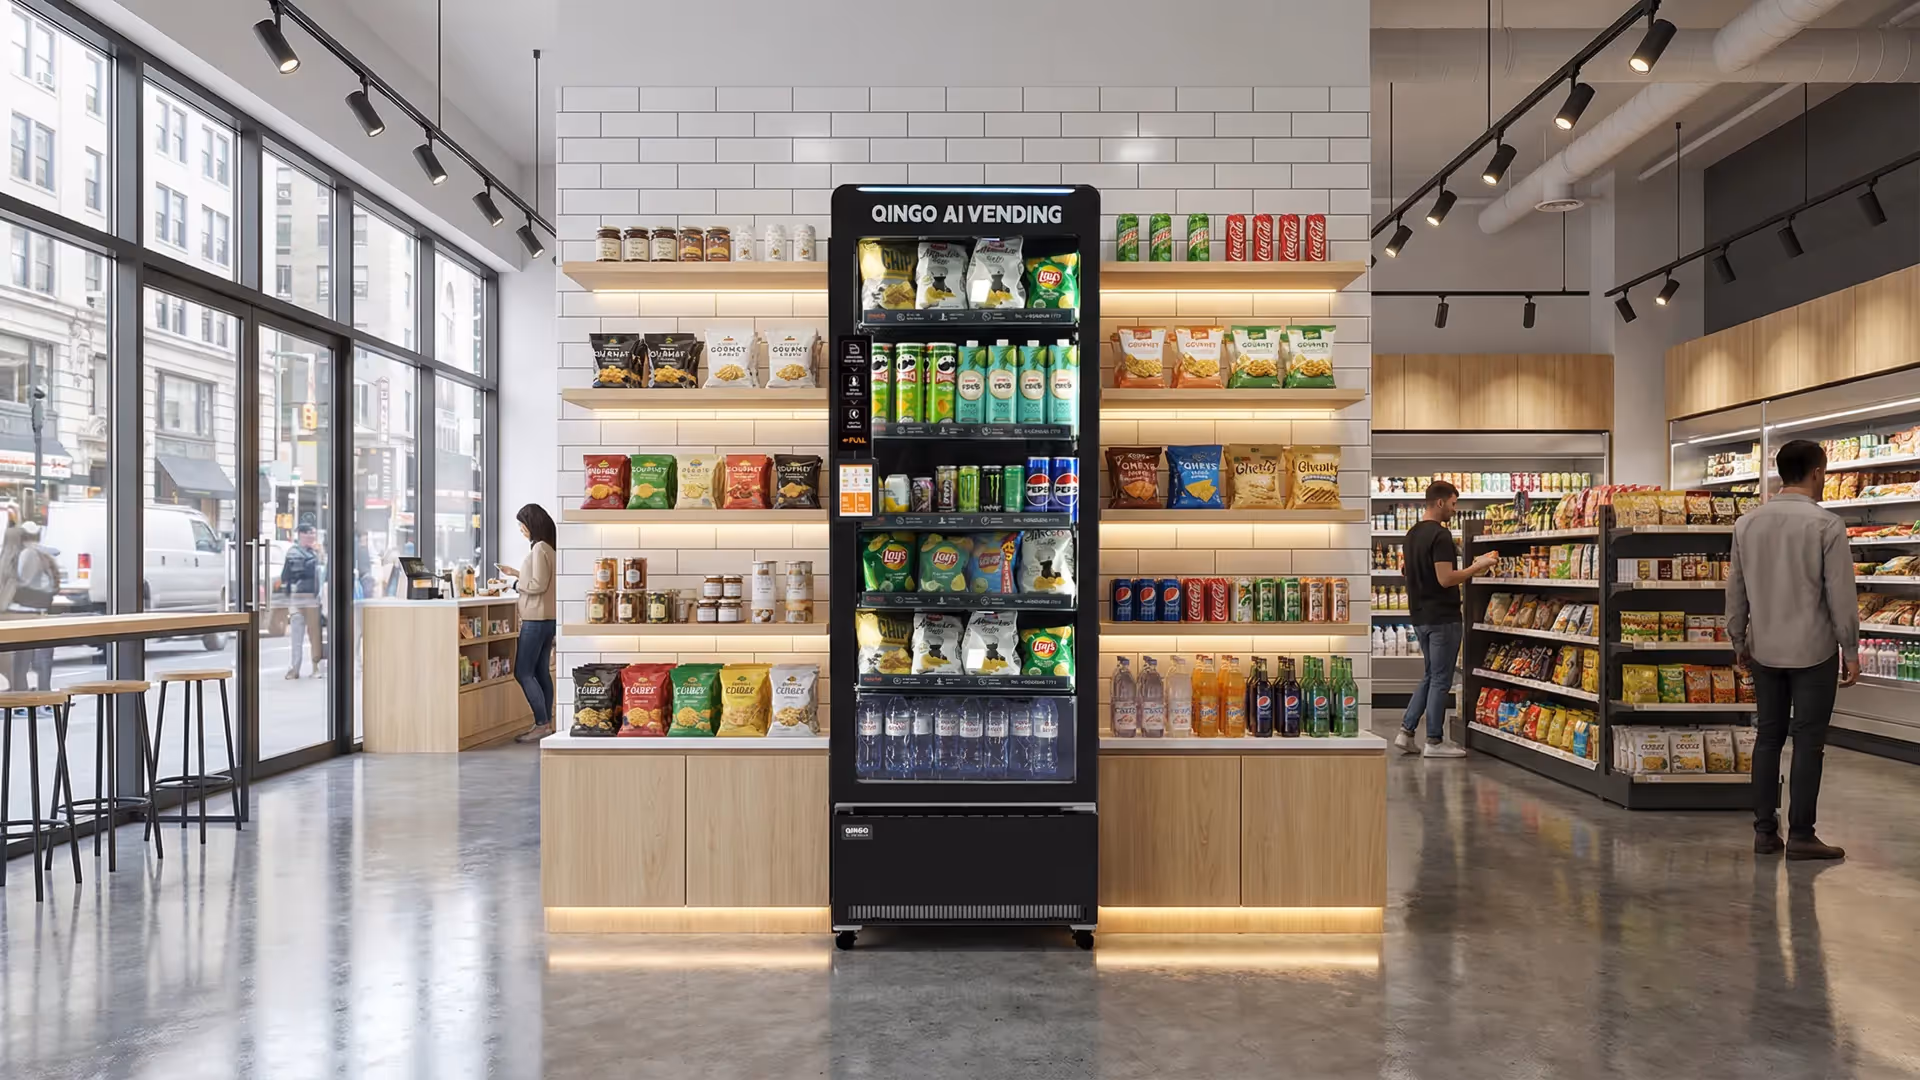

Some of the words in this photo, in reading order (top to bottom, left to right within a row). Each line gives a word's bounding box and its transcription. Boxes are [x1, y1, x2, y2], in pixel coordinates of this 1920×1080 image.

[871, 204, 938, 223] QINGO
[943, 205, 963, 223] AI
[967, 205, 1062, 224] VENDING
